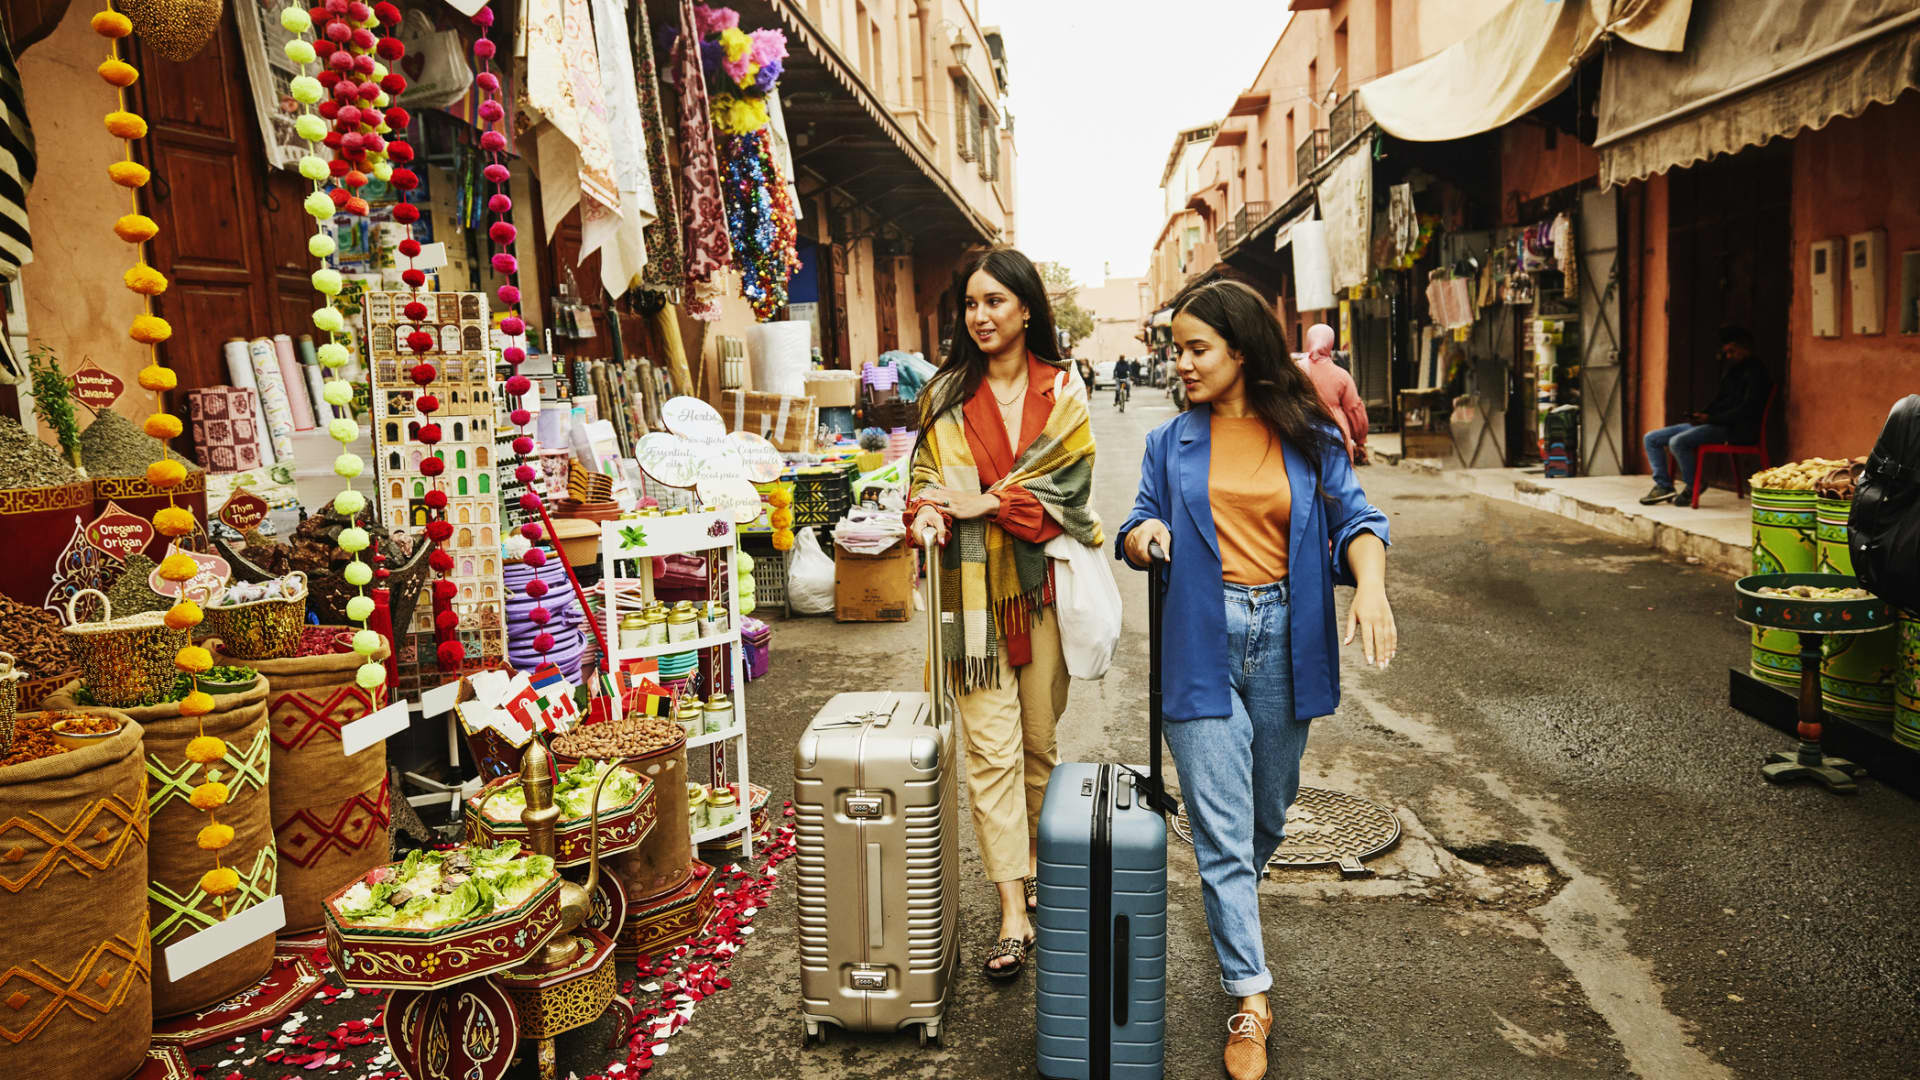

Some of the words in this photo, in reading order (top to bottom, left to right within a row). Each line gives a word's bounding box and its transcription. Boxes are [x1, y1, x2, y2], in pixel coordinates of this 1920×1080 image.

[76, 373, 114, 385] Lavender
[78, 386, 115, 399] Lavande
[677, 408, 719, 422] Herbs
[230, 503, 254, 513] Thym
[232, 512, 262, 524] Thyme
[100, 524, 143, 538] Oregano
[103, 536, 143, 552] Origan
